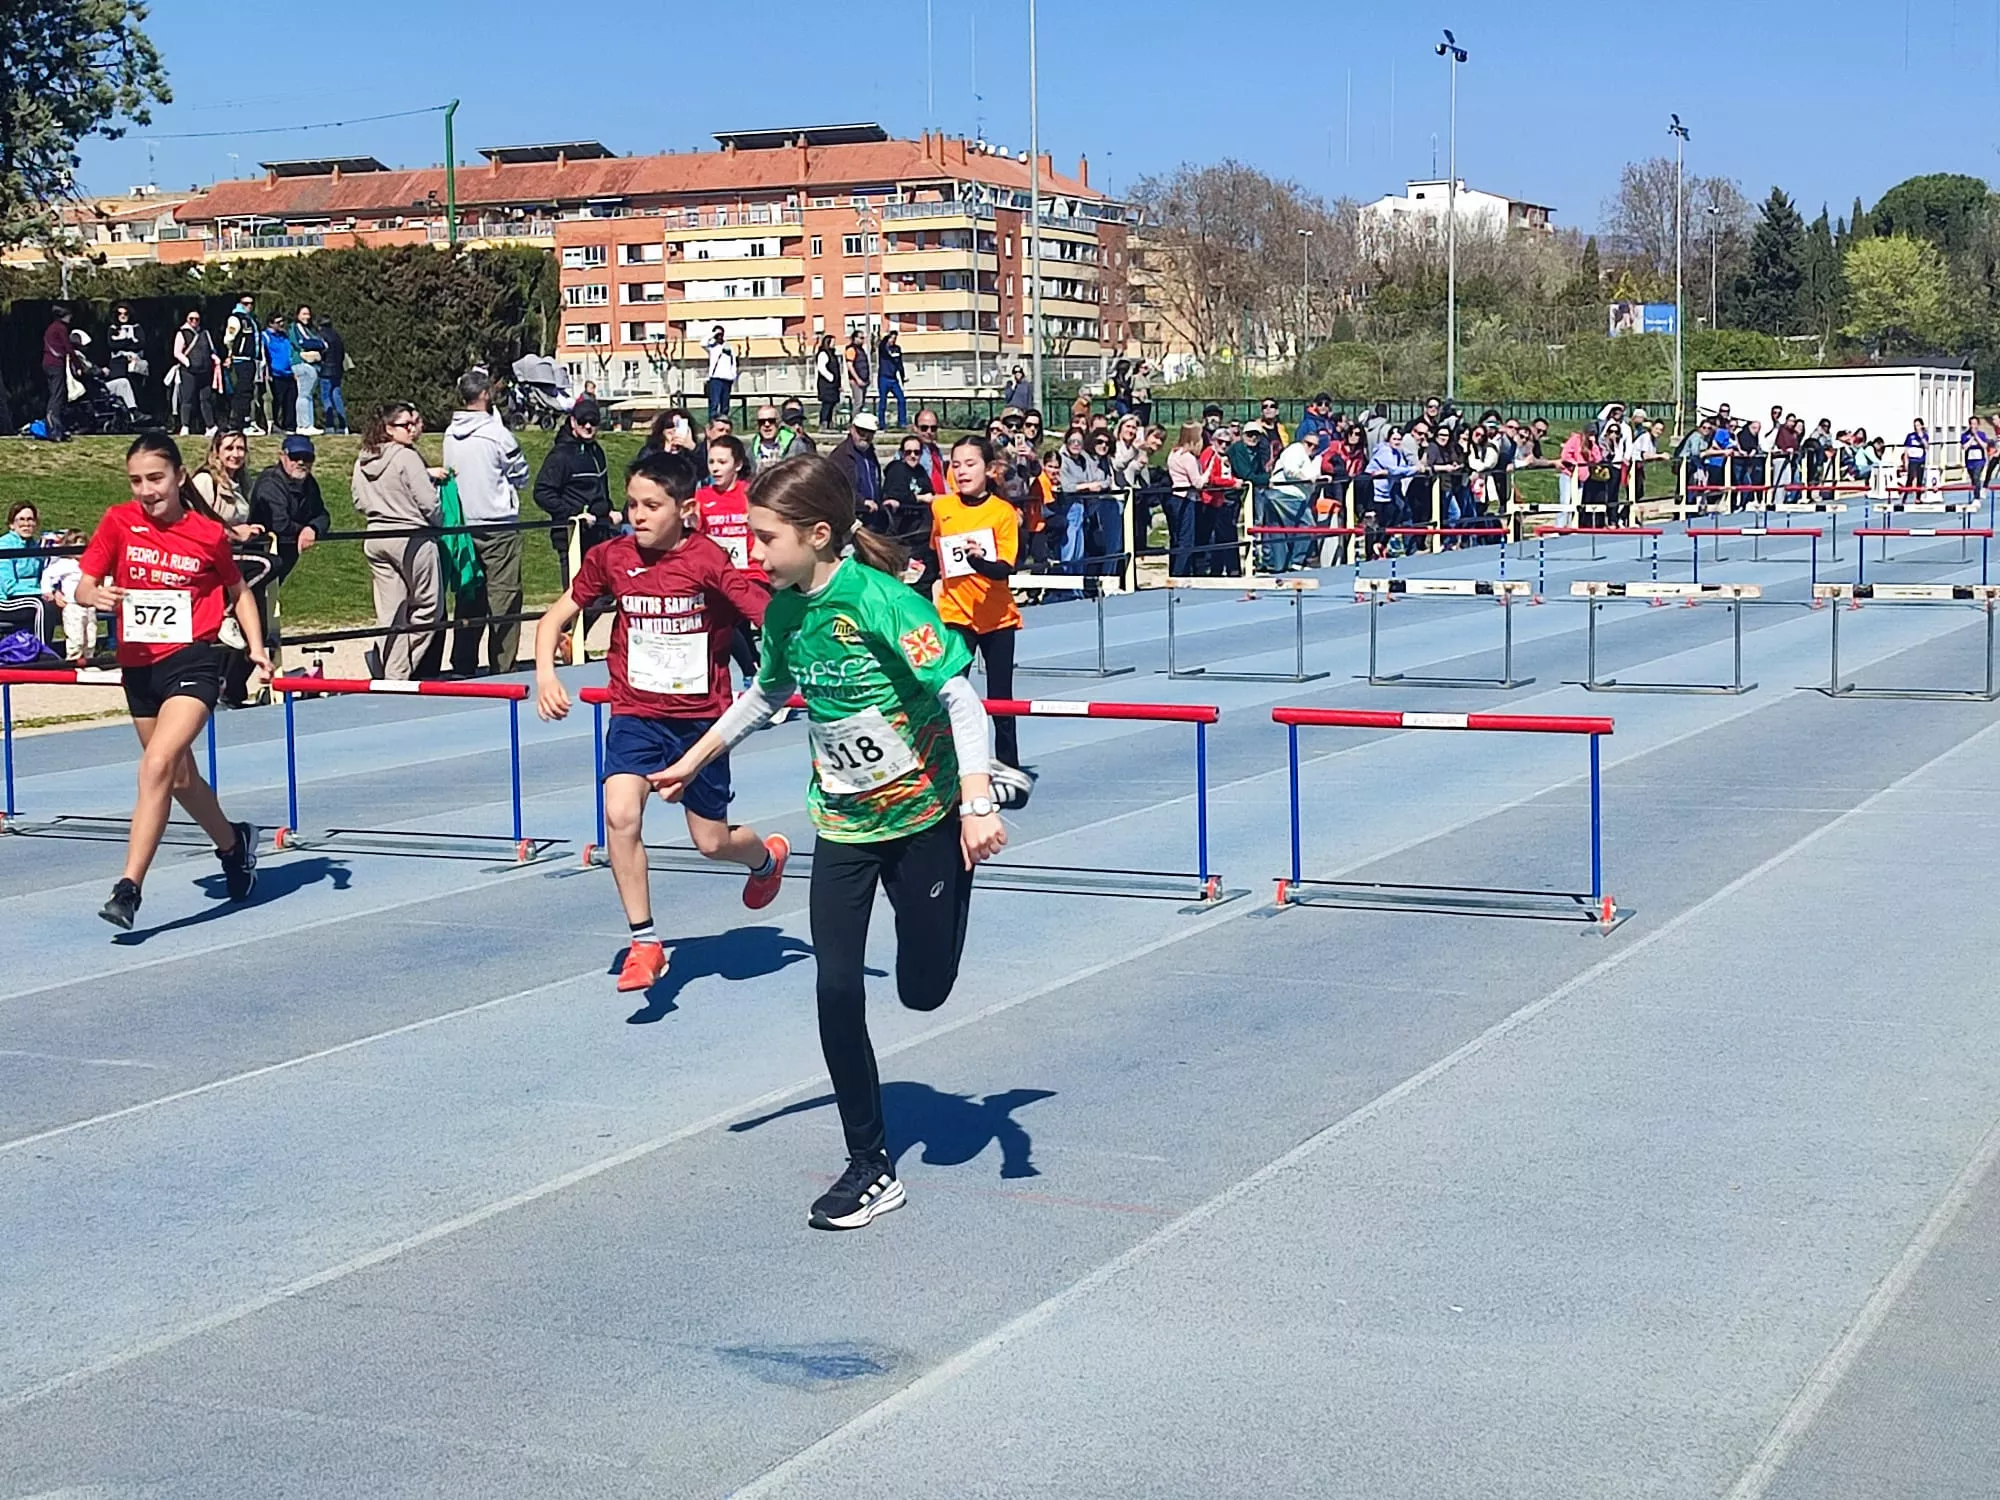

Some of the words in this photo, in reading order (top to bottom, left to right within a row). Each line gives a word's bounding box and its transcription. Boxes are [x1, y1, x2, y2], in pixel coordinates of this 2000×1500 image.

[126, 545, 160, 565] PEDRO
[161, 552, 169, 567] J.
[169, 554, 200, 573] RUBIO
[134, 605, 177, 625] 572
[621, 595, 662, 614] SANTOS
[824, 736, 884, 771] 518
